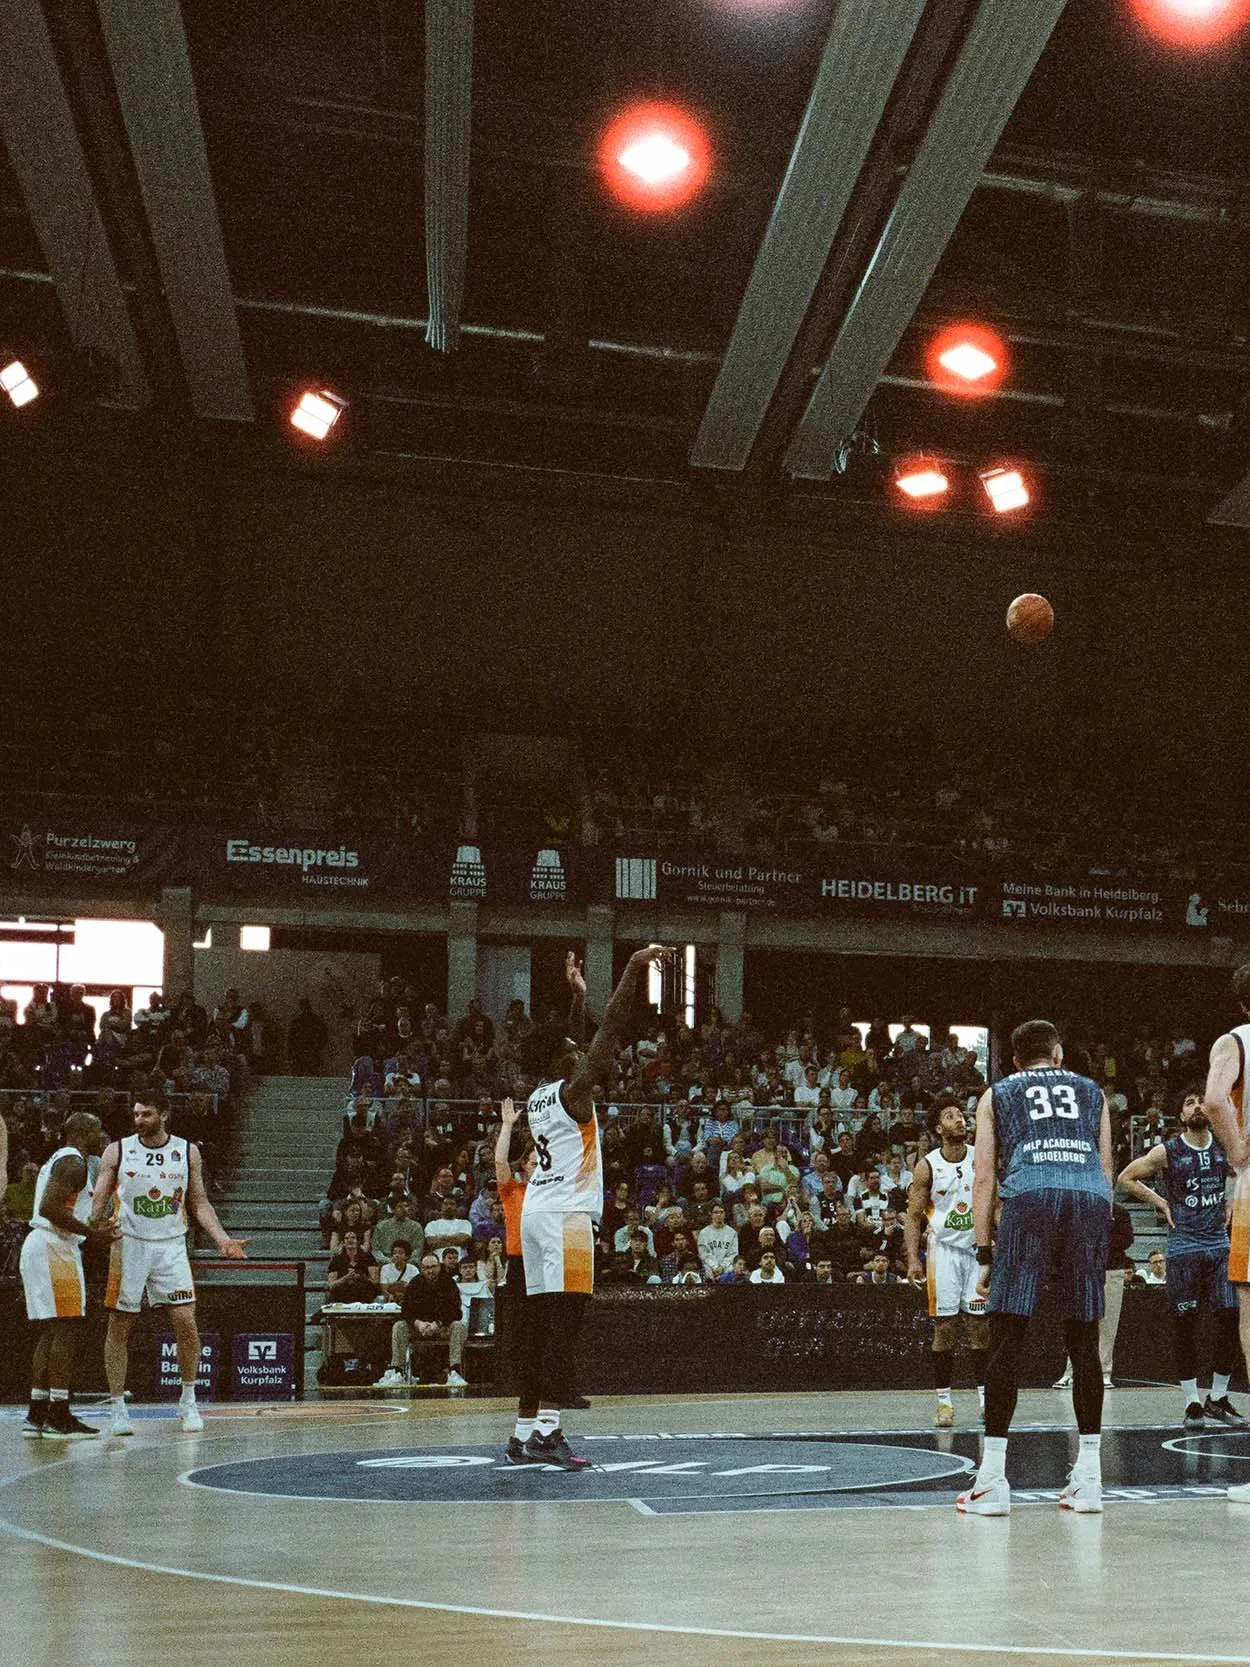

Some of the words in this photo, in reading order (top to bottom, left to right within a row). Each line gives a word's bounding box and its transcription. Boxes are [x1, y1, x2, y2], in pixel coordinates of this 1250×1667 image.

[46, 833, 136, 854] Purzelzwerg
[227, 839, 359, 871] Essenpreis
[661, 861, 709, 878] Gornik
[715, 866, 743, 880] und
[748, 867, 802, 884] Partner
[301, 874, 369, 888] HAUSTECHNIK
[450, 876, 487, 888] KRAUS
[530, 880, 566, 890] KRAUS
[450, 887, 487, 898] GRUPPE
[530, 890, 566, 900] GRUPPE
[821, 879, 954, 903] HEIDELBERG
[1003, 882, 1040, 896] Meine
[1045, 884, 1075, 898] Bank
[1079, 886, 1091, 898] in
[1031, 902, 1100, 918] Volksbank
[1105, 904, 1162, 922] Kurpfalz
[1025, 1085, 1079, 1120] 33
[1023, 1139, 1041, 1152] MLP
[1043, 1138, 1092, 1152] ACADEMICS
[146, 1153, 164, 1167] 29
[1032, 1151, 1086, 1165] HEIDELBERG
[1198, 1152, 1211, 1166] 15
[956, 1166, 963, 1179] 5
[136, 1198, 173, 1214] Karls
[947, 1212, 973, 1226] Karl
[237, 1365, 287, 1375] Volksbank
[241, 1376, 283, 1386] Kurpfalz
